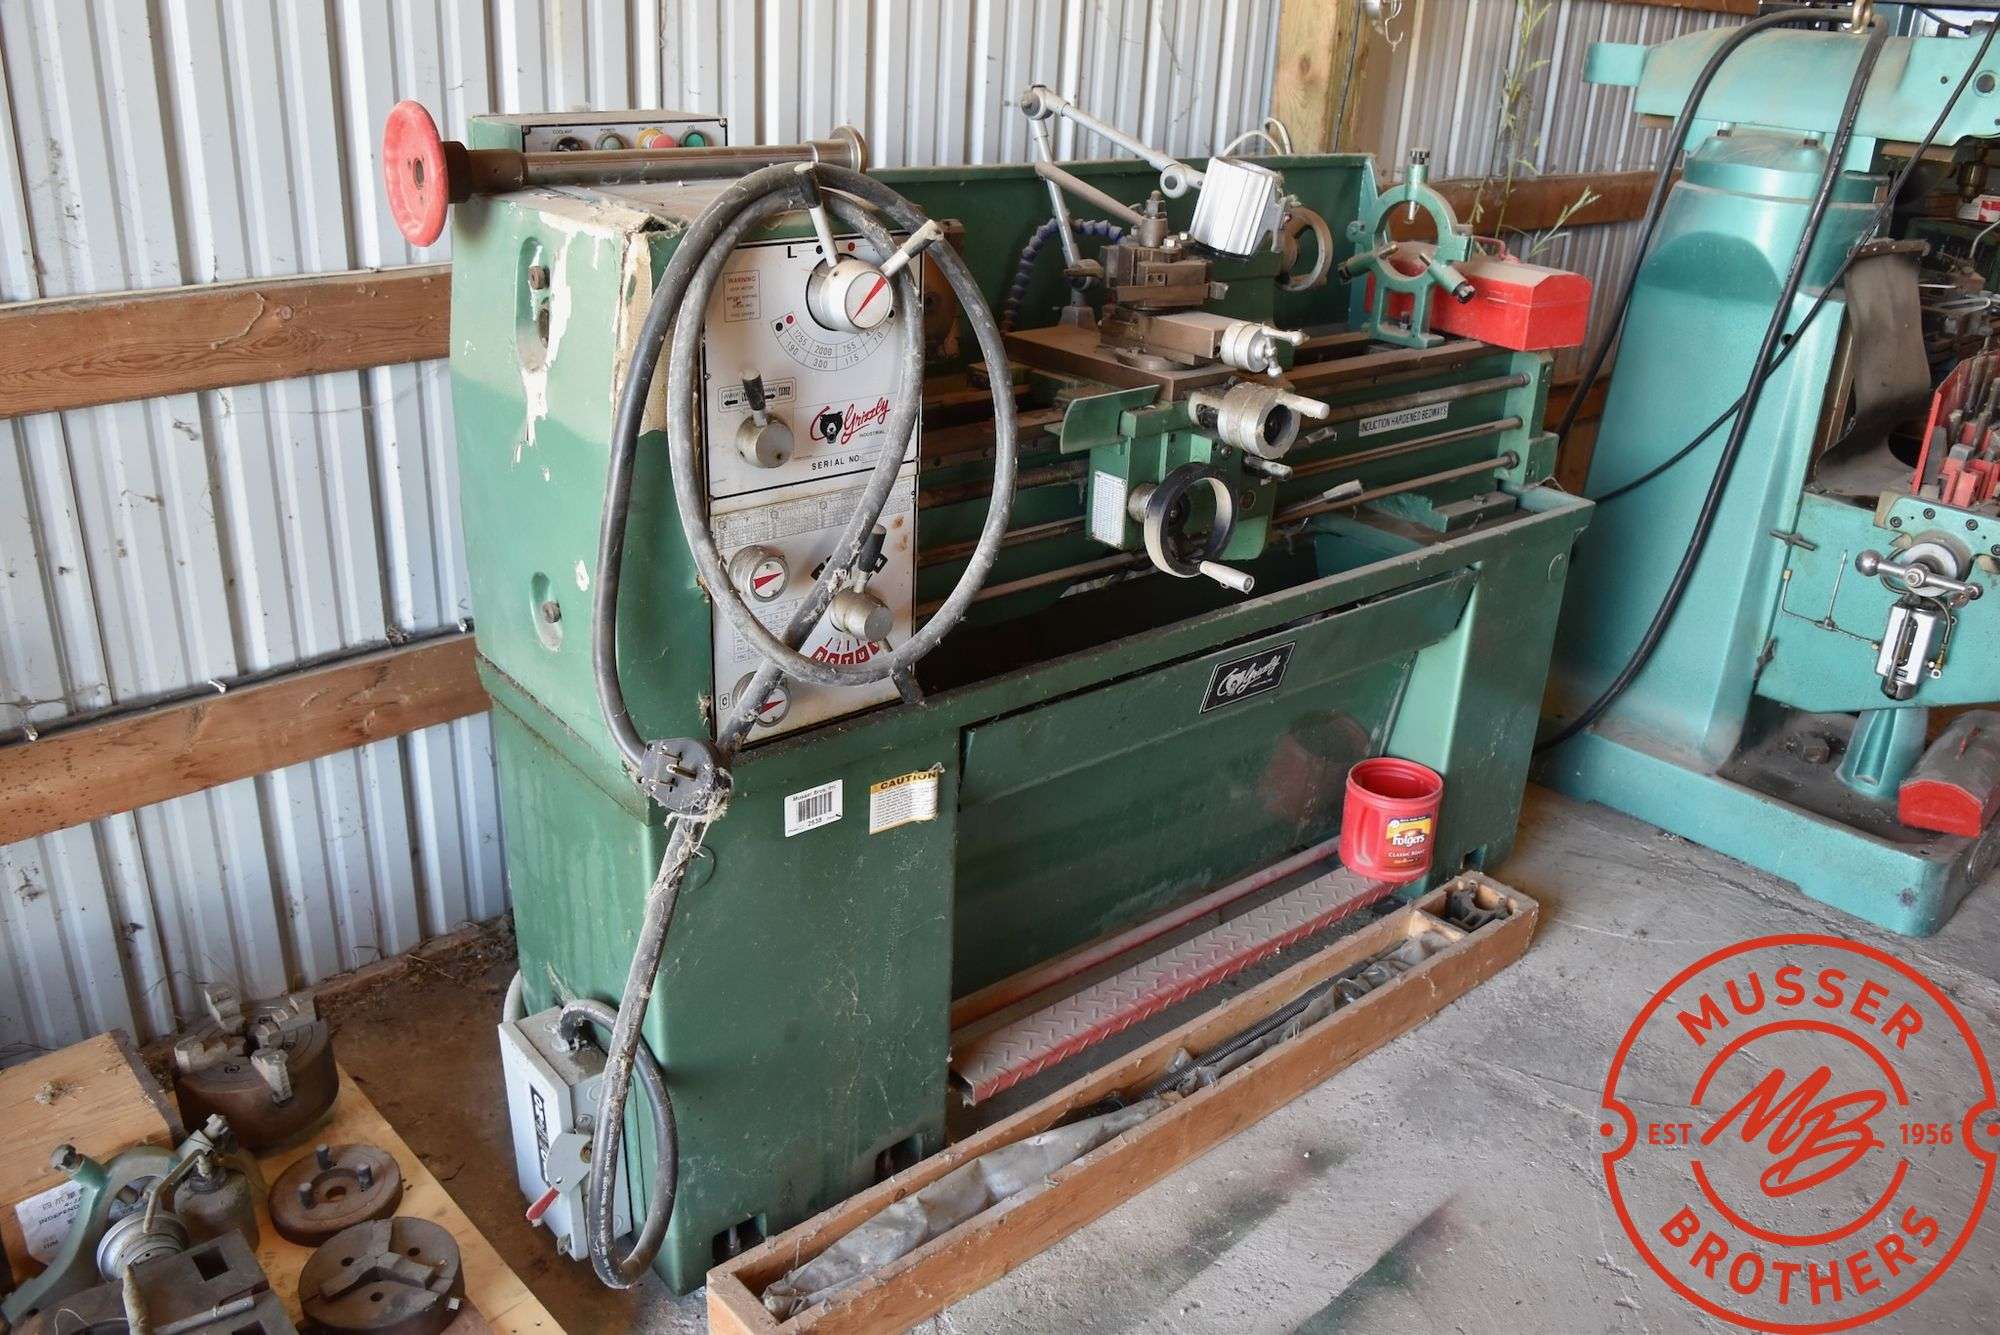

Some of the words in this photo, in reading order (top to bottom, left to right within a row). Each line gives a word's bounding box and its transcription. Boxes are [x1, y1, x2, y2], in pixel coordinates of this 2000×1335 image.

[787, 246, 797, 258] L
[813, 358, 828, 369] 300
[1360, 418, 1390, 433] INDUCTION
[1391, 411, 1421, 425] HARDENED
[1421, 405, 1448, 419] BEDWAYS
[811, 458, 845, 470] SERIAL
[880, 771, 937, 790] CAUTION
[1391, 833, 1425, 848] Folgers
